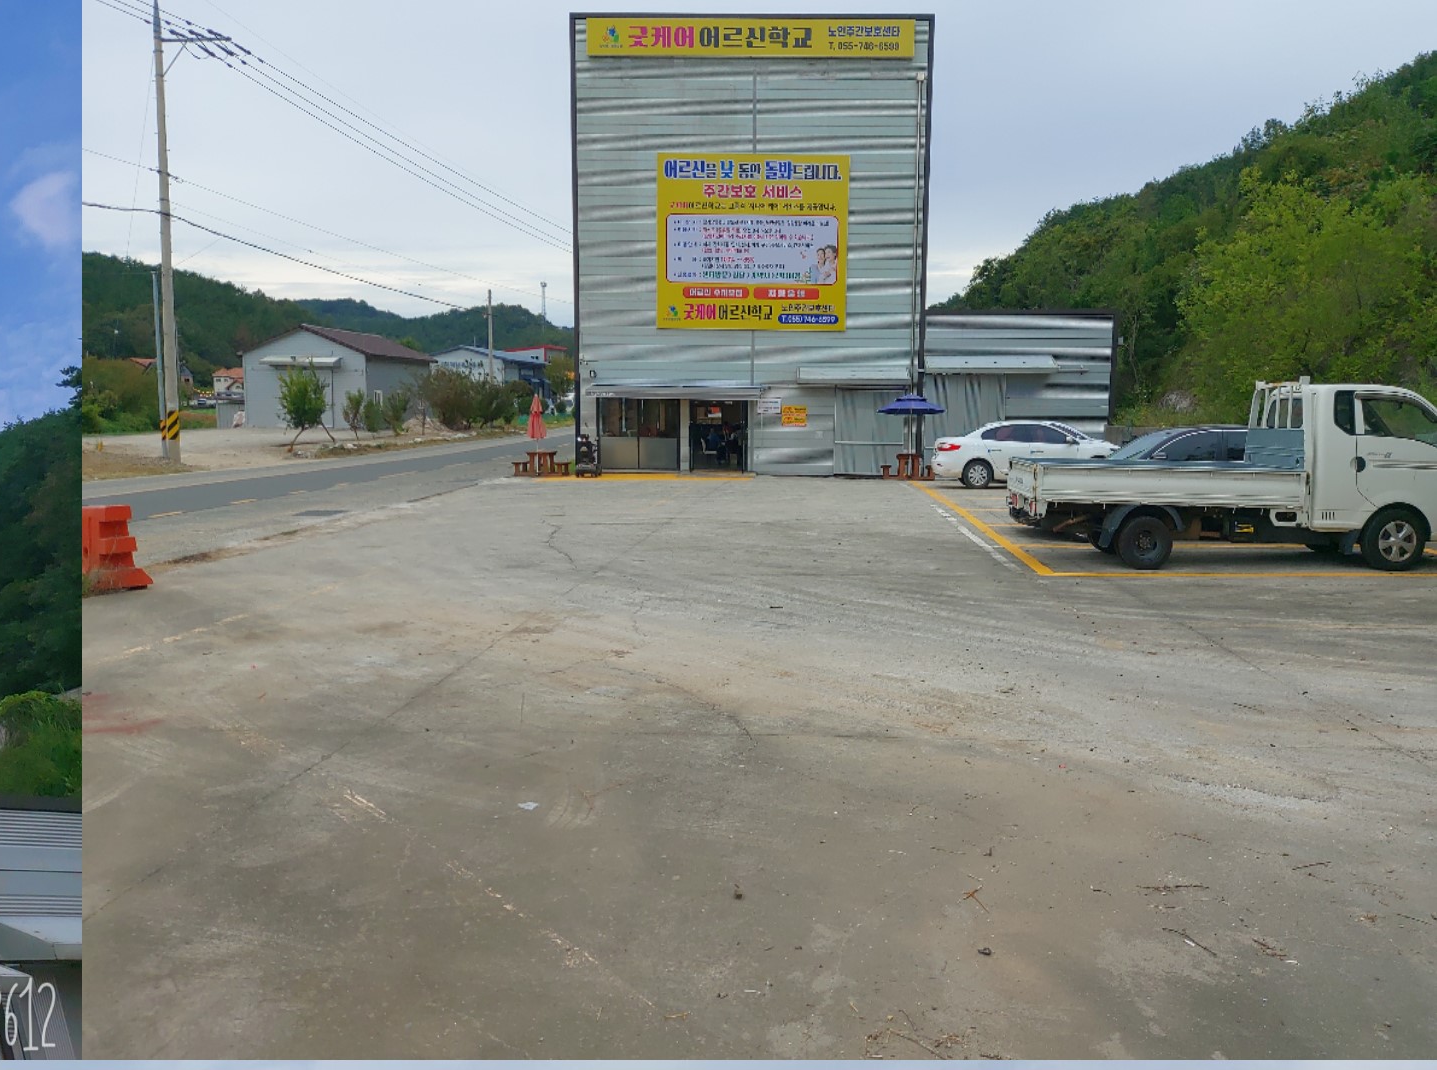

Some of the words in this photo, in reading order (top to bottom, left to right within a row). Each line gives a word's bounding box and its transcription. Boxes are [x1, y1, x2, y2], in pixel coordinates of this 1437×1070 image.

[628, 26, 694, 48] 굿케어
[699, 27, 812, 48] 어르신학교
[664, 160, 717, 179] 어르신을
[720, 160, 734, 178] 낮
[704, 184, 757, 198] 주간보호
[762, 185, 802, 198] 서비스
